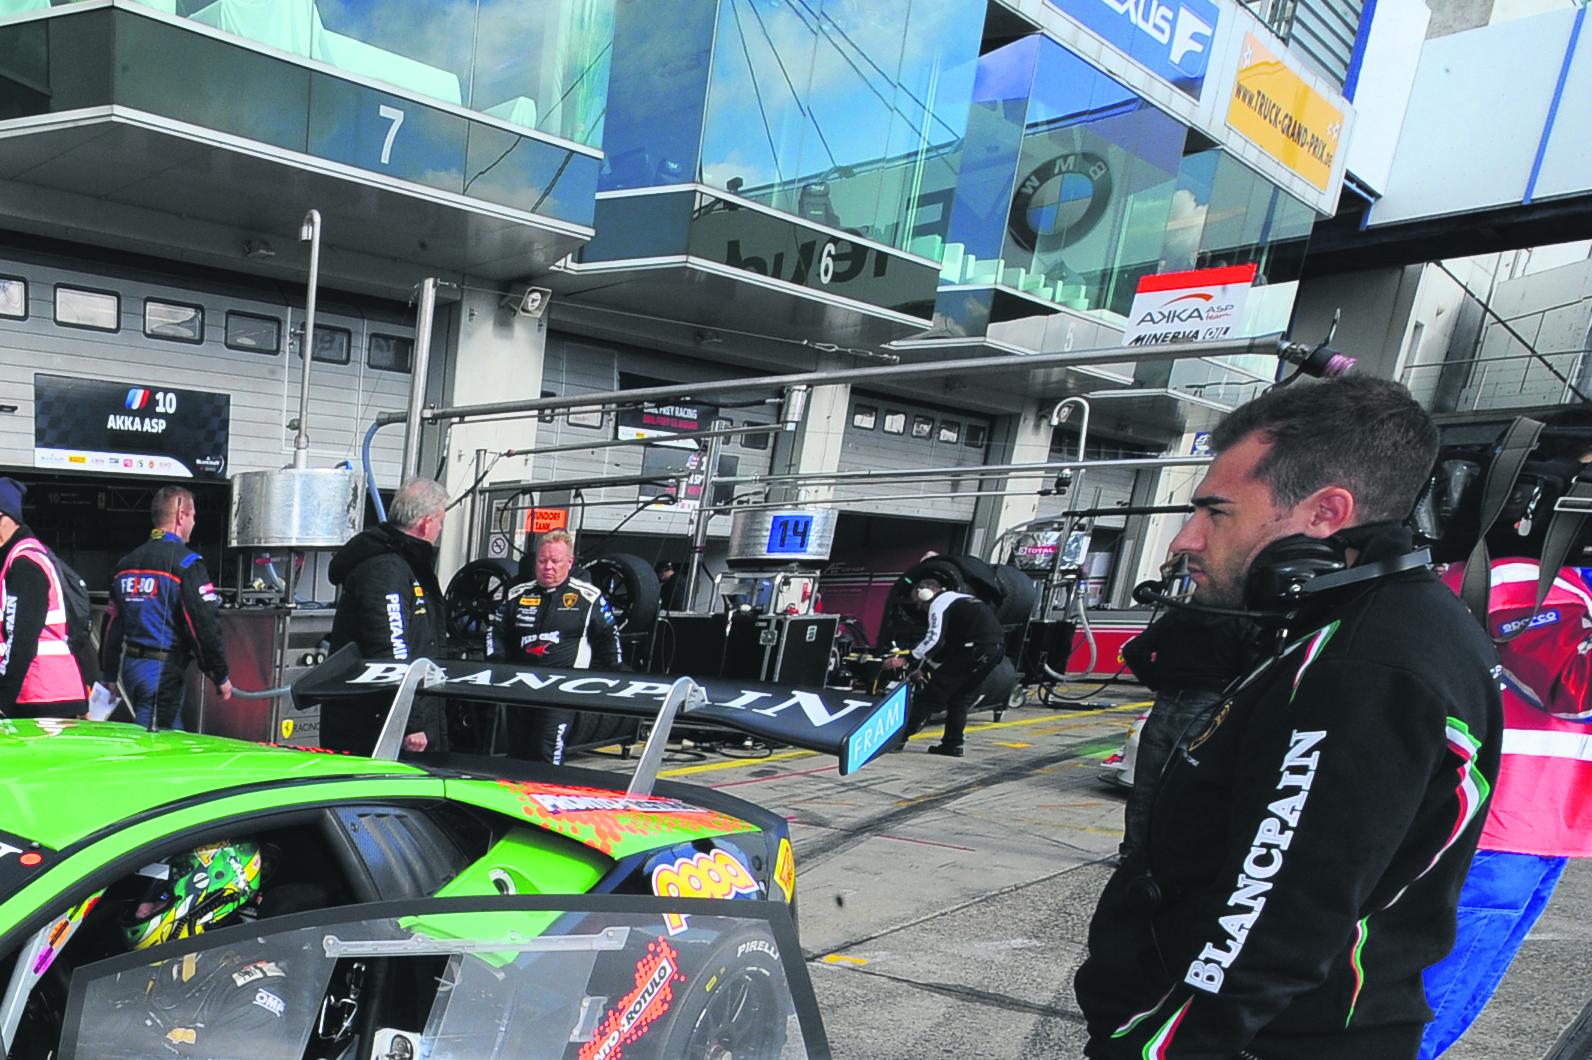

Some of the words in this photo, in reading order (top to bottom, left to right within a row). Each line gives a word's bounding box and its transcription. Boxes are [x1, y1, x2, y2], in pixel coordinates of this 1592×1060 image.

[377, 105, 405, 165] 7
[819, 241, 836, 285] 6
[1206, 303, 1235, 314] ASP
[1128, 329, 1201, 346] MINERVA
[155, 391, 177, 414] 10
[107, 414, 142, 432] AKKA
[143, 418, 167, 434] ASP
[779, 519, 810, 549] 14
[1027, 546, 1055, 554] TOTAL
[345, 662, 875, 728] BANCPIN
[852, 700, 904, 763] FRAM
[1184, 728, 1327, 994] BLANCPAIN
[737, 940, 779, 960] PIRELLI
[255, 991, 284, 1014] OMP
